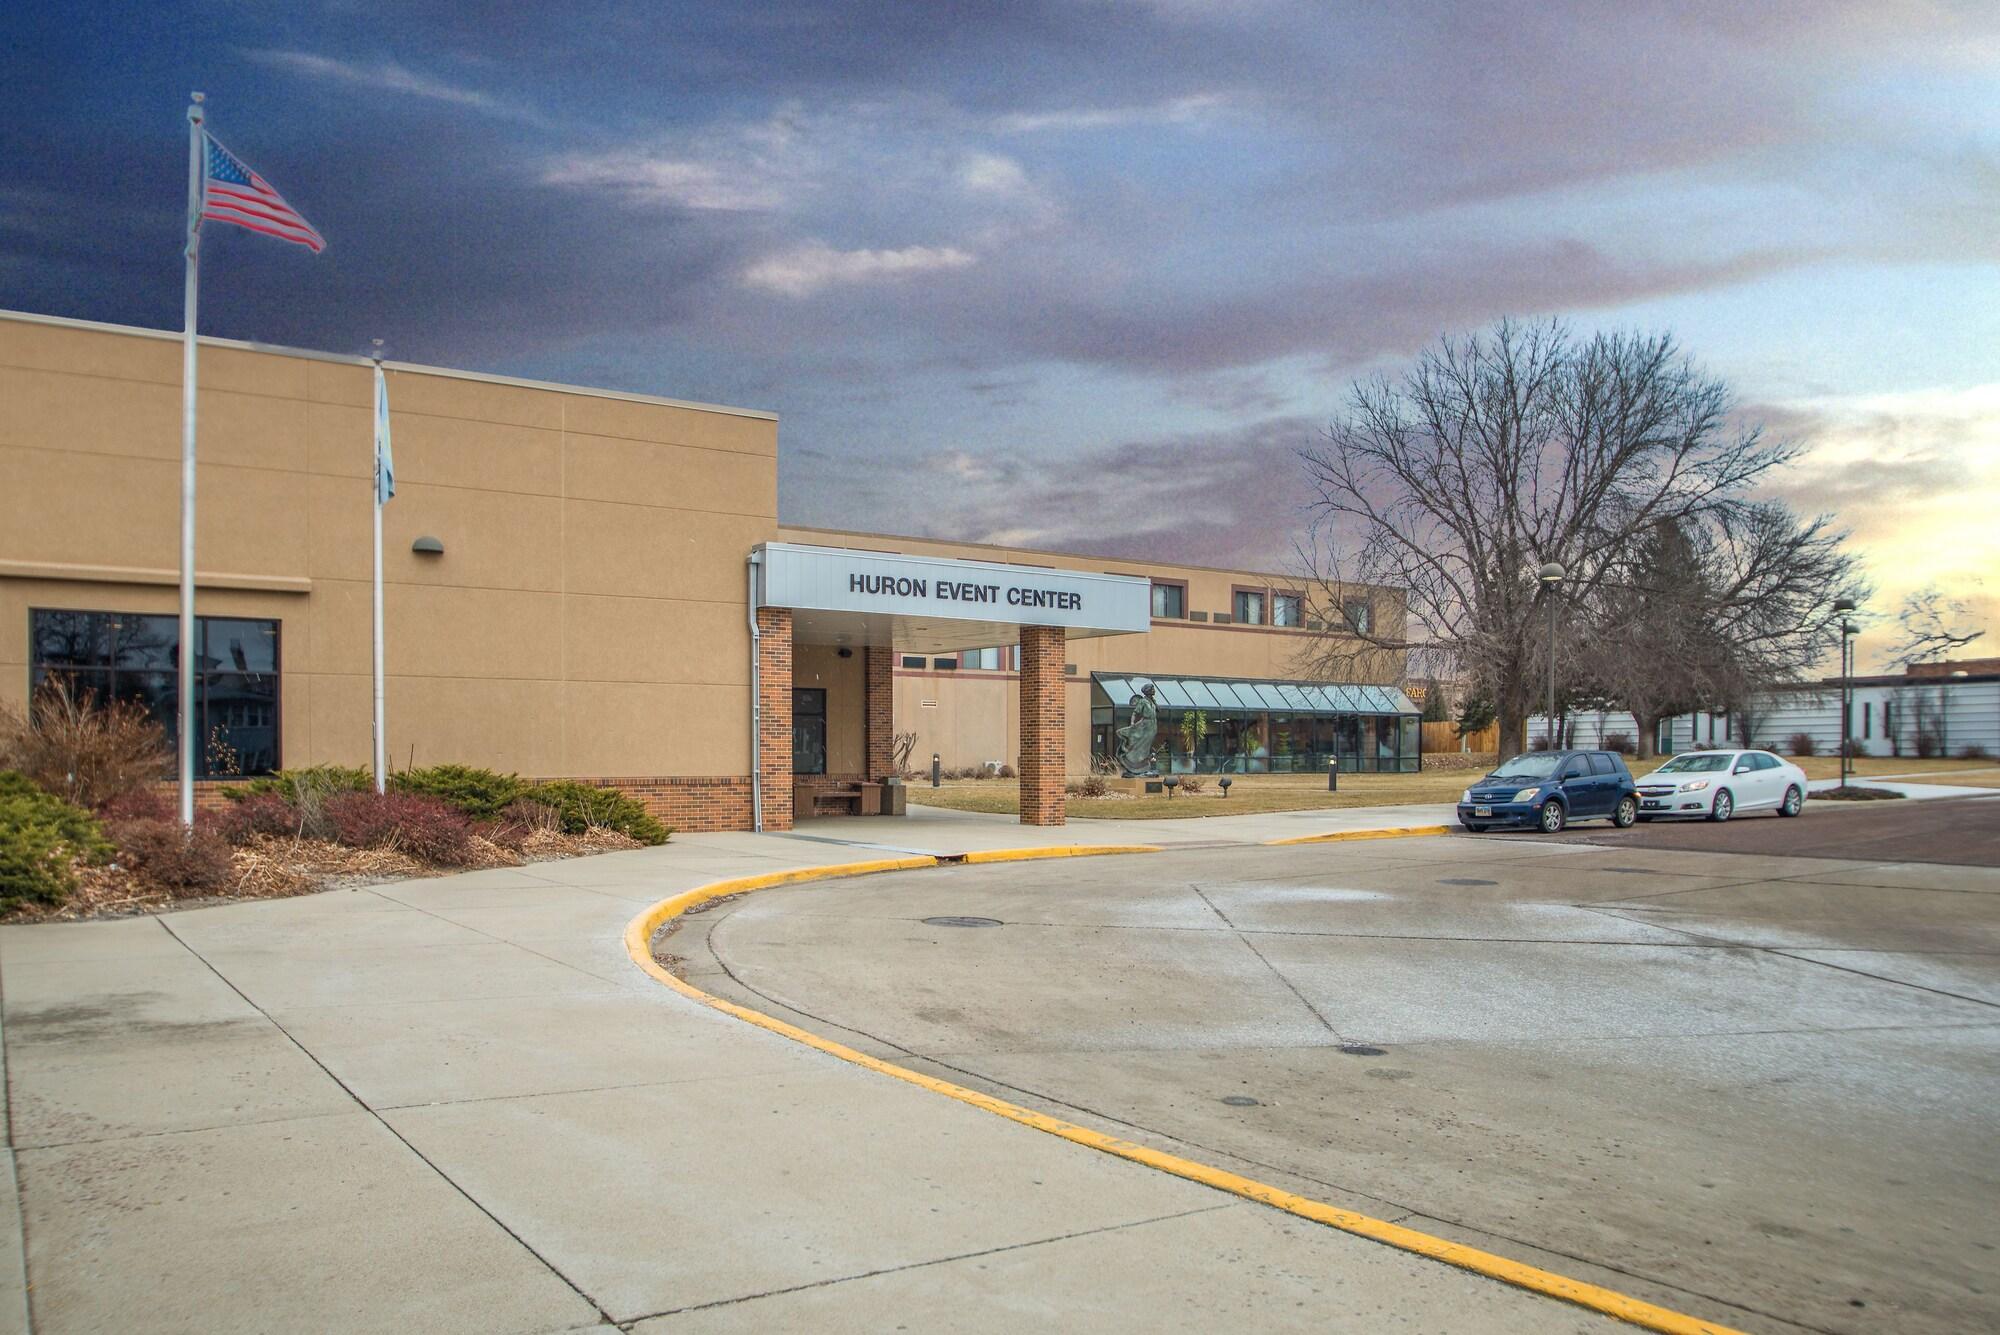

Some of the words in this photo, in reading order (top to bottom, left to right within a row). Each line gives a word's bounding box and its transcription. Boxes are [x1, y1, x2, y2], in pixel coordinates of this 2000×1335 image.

[850, 574, 927, 597] HURON
[936, 581, 1000, 603] EVENT
[1007, 587, 1081, 610] CENTER
